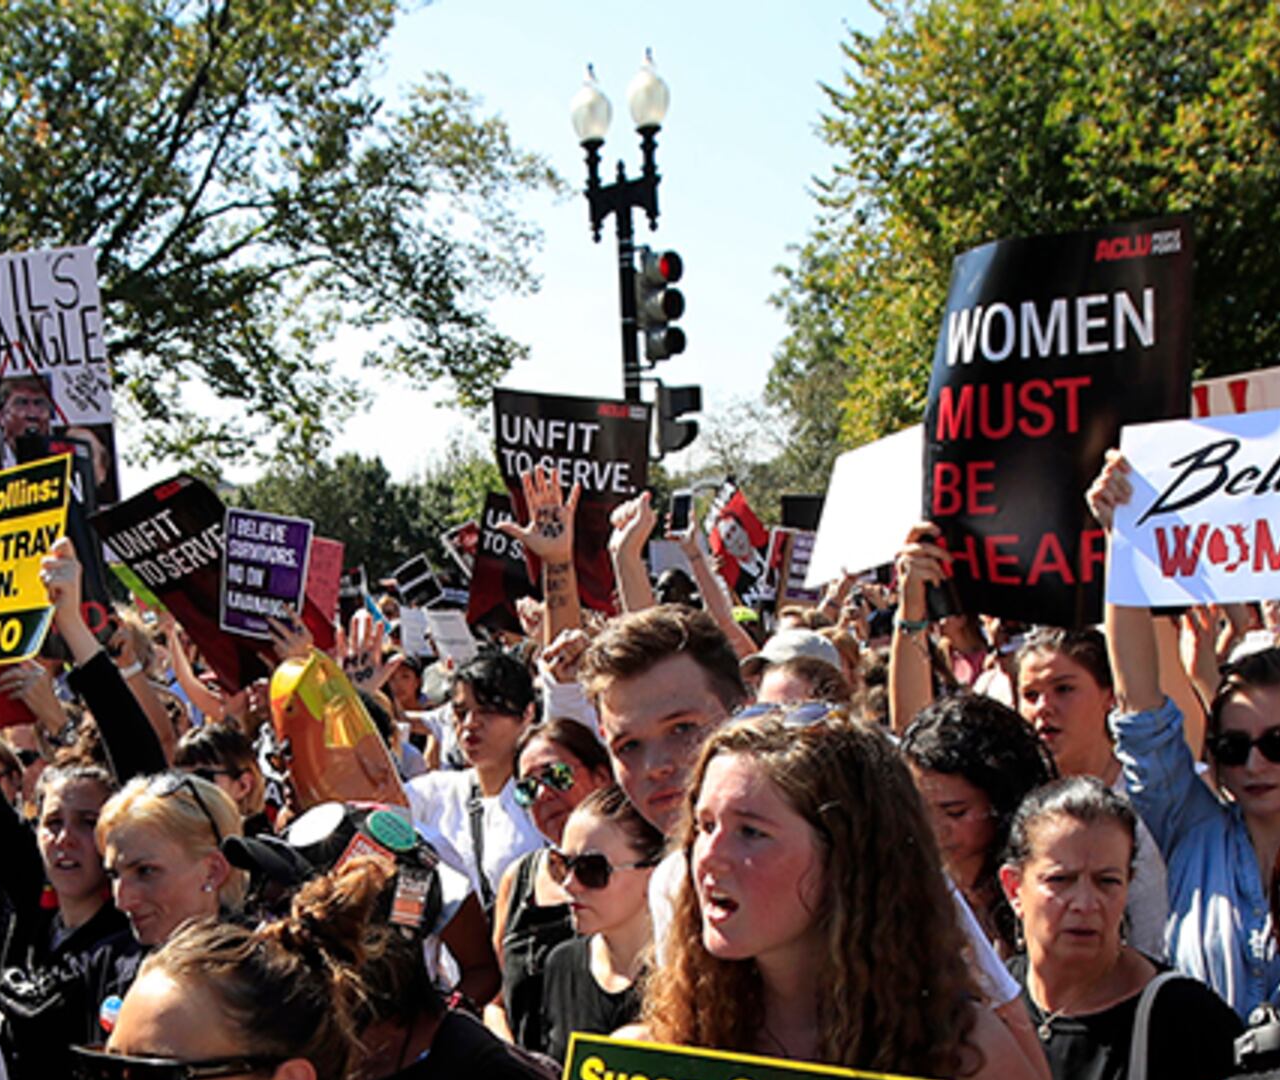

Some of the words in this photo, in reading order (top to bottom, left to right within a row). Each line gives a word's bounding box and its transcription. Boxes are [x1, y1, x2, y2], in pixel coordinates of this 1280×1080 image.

[945, 289, 1157, 368] WOMEN
[501, 414, 600, 454] UNFIT
[935, 375, 1091, 443] MUST
[501, 449, 533, 477] TO
[539, 456, 636, 494] SERVE.
[932, 460, 998, 518] BE
[108, 509, 183, 559] UNFIT
[133, 559, 168, 587] TO
[163, 523, 226, 579] SERVE
[237, 518, 289, 544] BELIEVE
[935, 529, 1105, 586] HEAR
